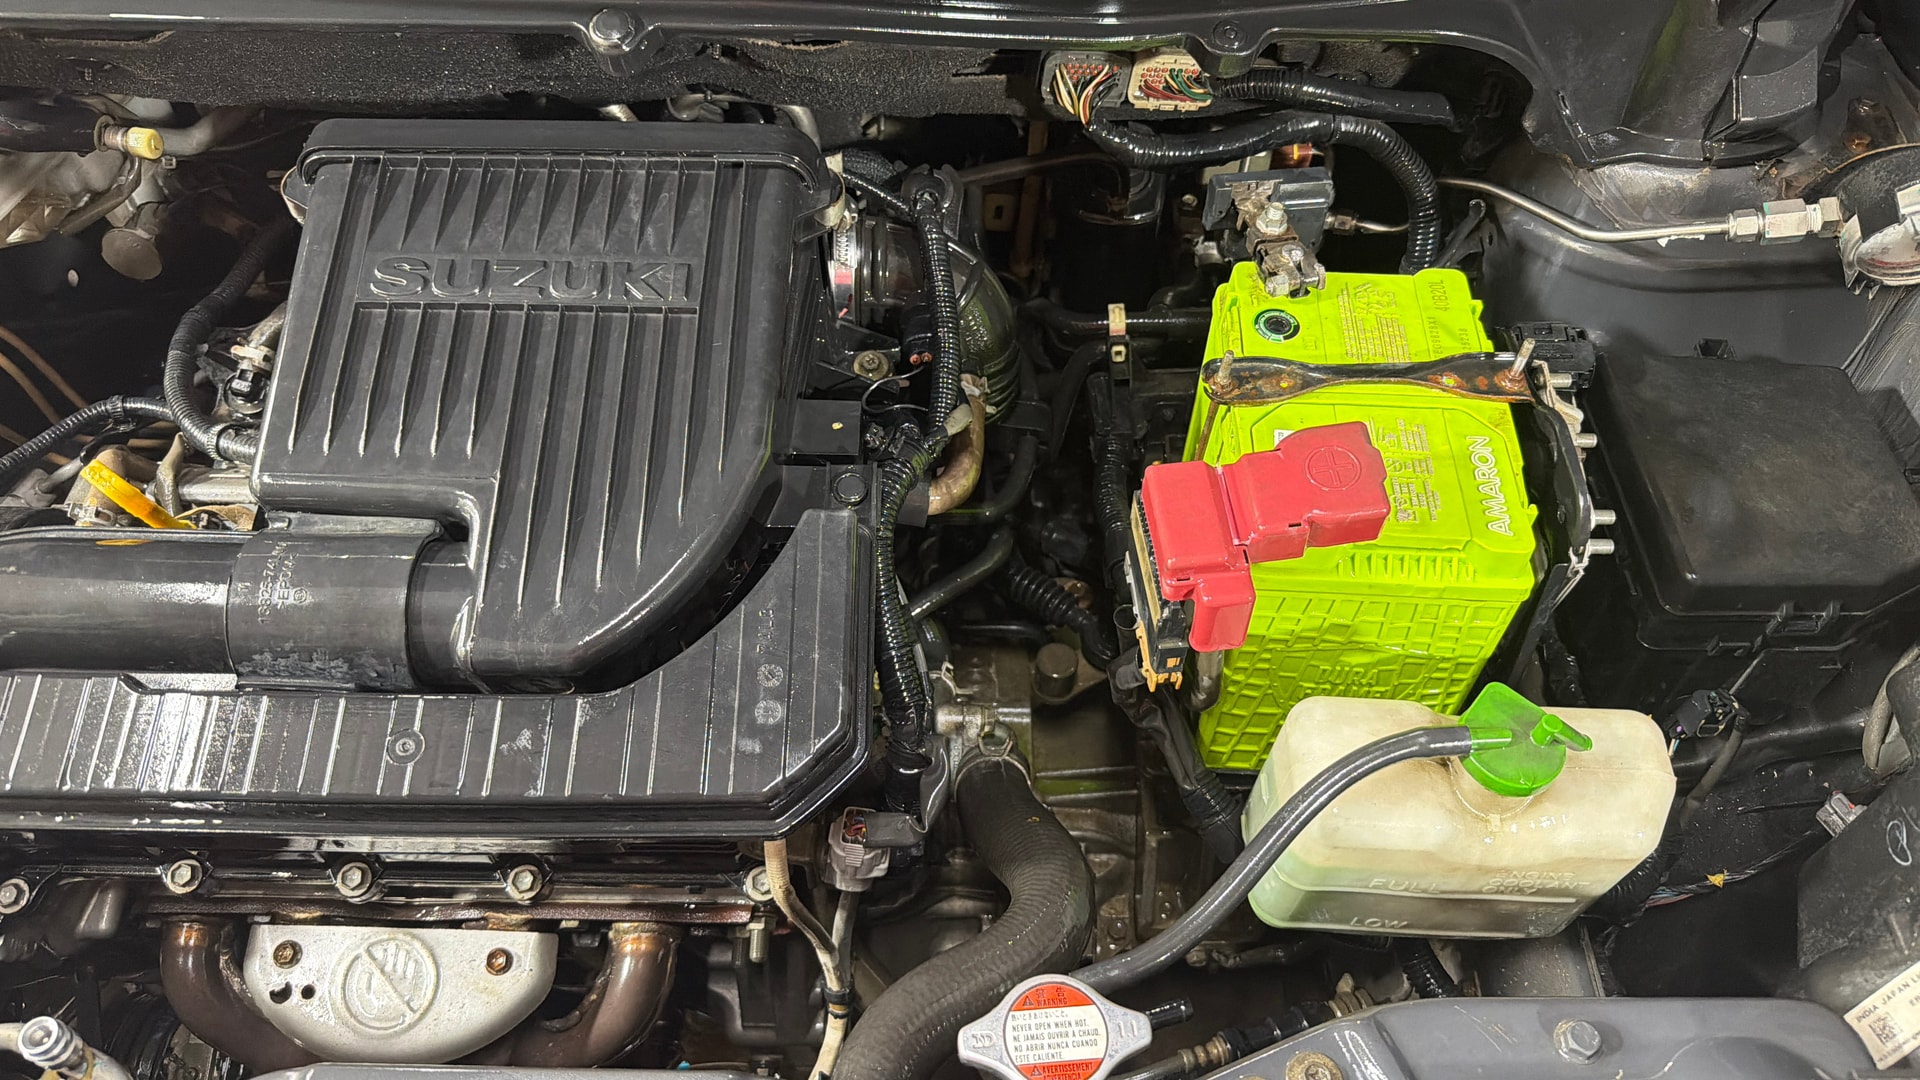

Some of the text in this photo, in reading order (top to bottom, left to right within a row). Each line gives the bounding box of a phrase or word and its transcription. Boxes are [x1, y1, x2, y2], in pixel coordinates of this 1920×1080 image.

[370, 256, 693, 301] SUZUKI
[1428, 279, 1450, 312] 40B20L
[1466, 435, 1514, 537] AMARON
[1314, 665, 1378, 685] DURA
[1495, 871, 1577, 880] ENGINE
[1368, 878, 1441, 894] FULL
[1488, 878, 1591, 889] COOLANT
[1482, 886, 1538, 895] ONLY
[1350, 916, 1409, 929] LOW
[1037, 998, 1068, 1007] WARNING
[1012, 1018, 1089, 1032] NEVER OPEN WHEN HOT.
[1013, 1033, 1020, 1042] NE
[1023, 1032, 1045, 1042] JAMAIS
[1047, 1031, 1070, 1040] OUVRIR
[1014, 1039, 1098, 1053] NO ABRIR NUNCA CUANDO
[1015, 1054, 1030, 1063] ESTE
[1042, 1062, 1094, 1074] AVERTISSEMENT
